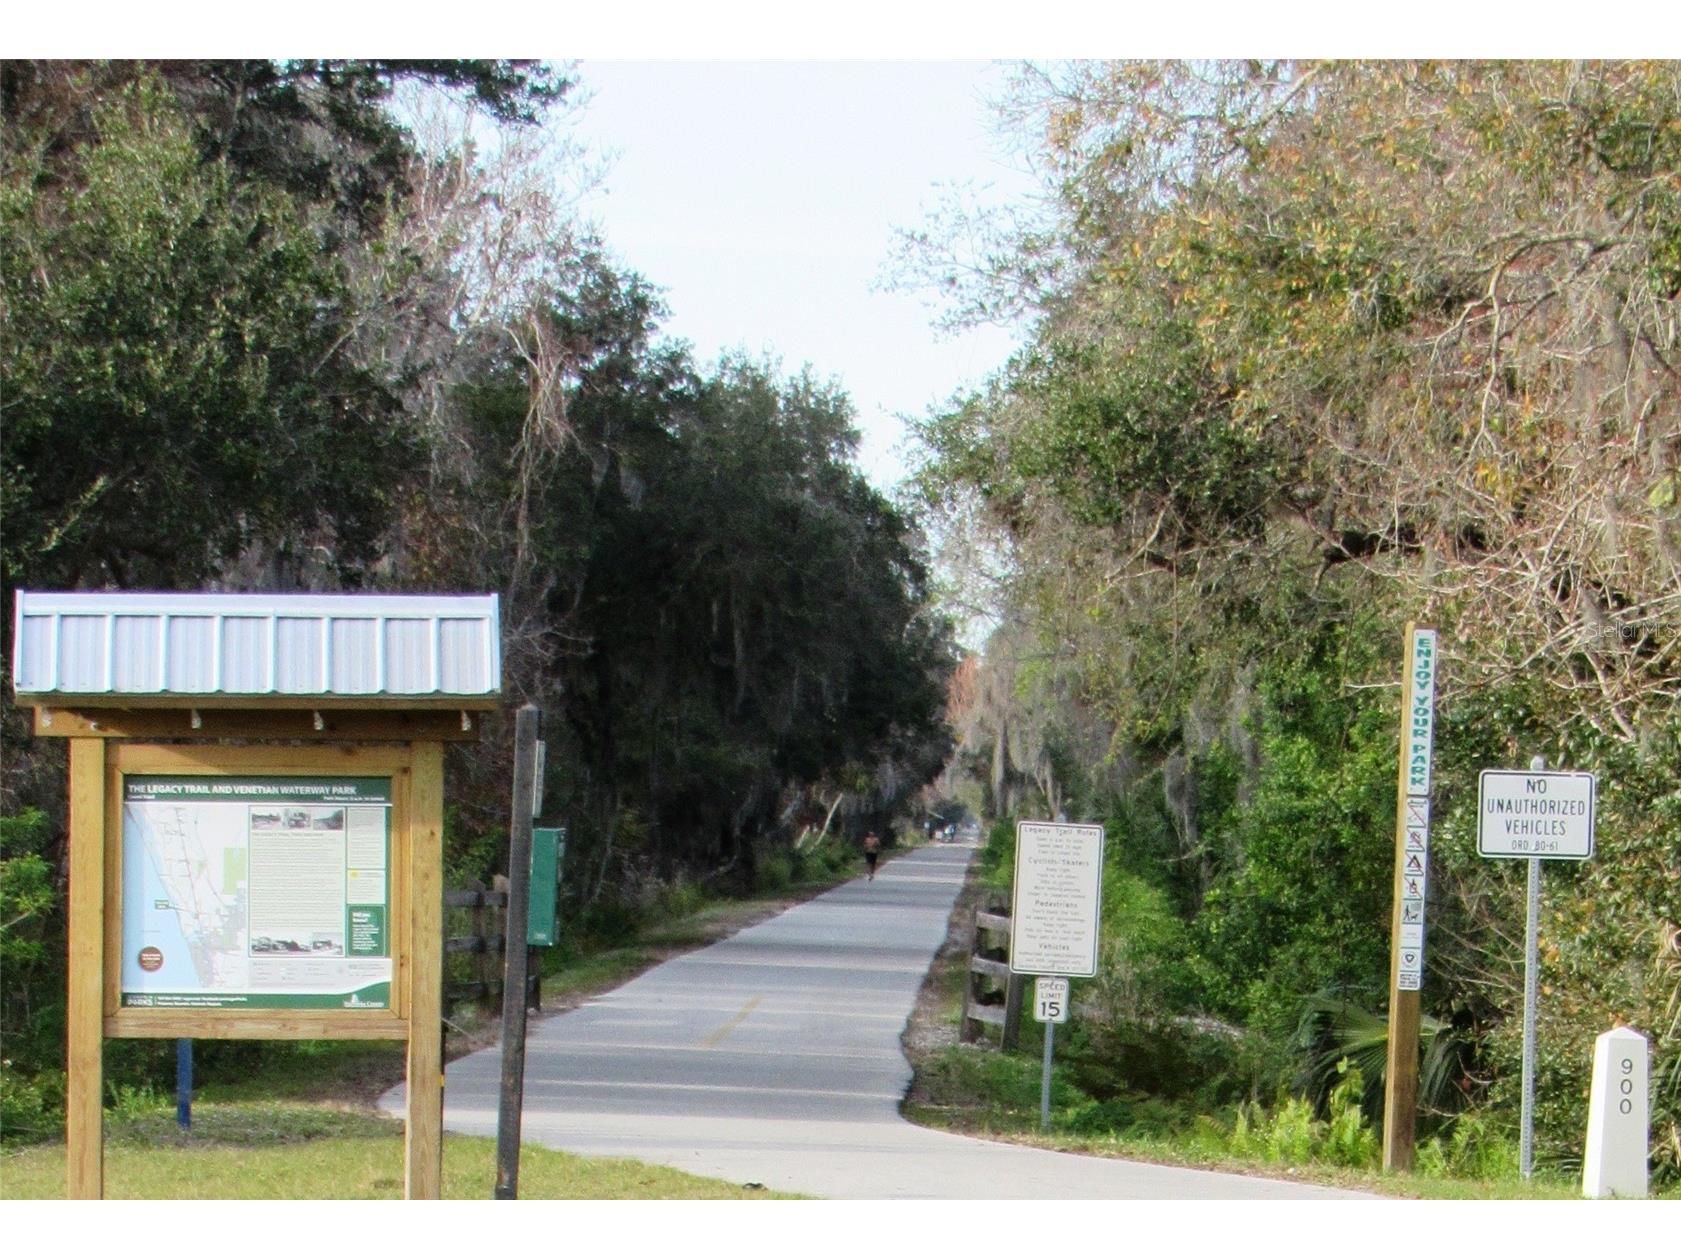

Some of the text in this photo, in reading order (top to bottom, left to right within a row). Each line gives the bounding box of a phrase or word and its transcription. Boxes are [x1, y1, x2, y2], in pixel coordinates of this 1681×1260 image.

[1415, 638, 1431, 690] ENJOY
[1413, 696, 1429, 738] YOUR
[1411, 744, 1426, 786] PARK
[128, 784, 356, 795] THE LEGACY TRAIL AND VENETIAN WATERWAY PARK
[1526, 779, 1547, 794] NO
[1487, 799, 1585, 816] UNAUTHORIZED
[1505, 819, 1566, 836] VEHICLES
[1034, 900, 1078, 909] Pedestrians
[1039, 982, 1066, 991] SPEED
[1041, 1001, 1060, 1017] 15
[1619, 1058, 1633, 1115] 900
